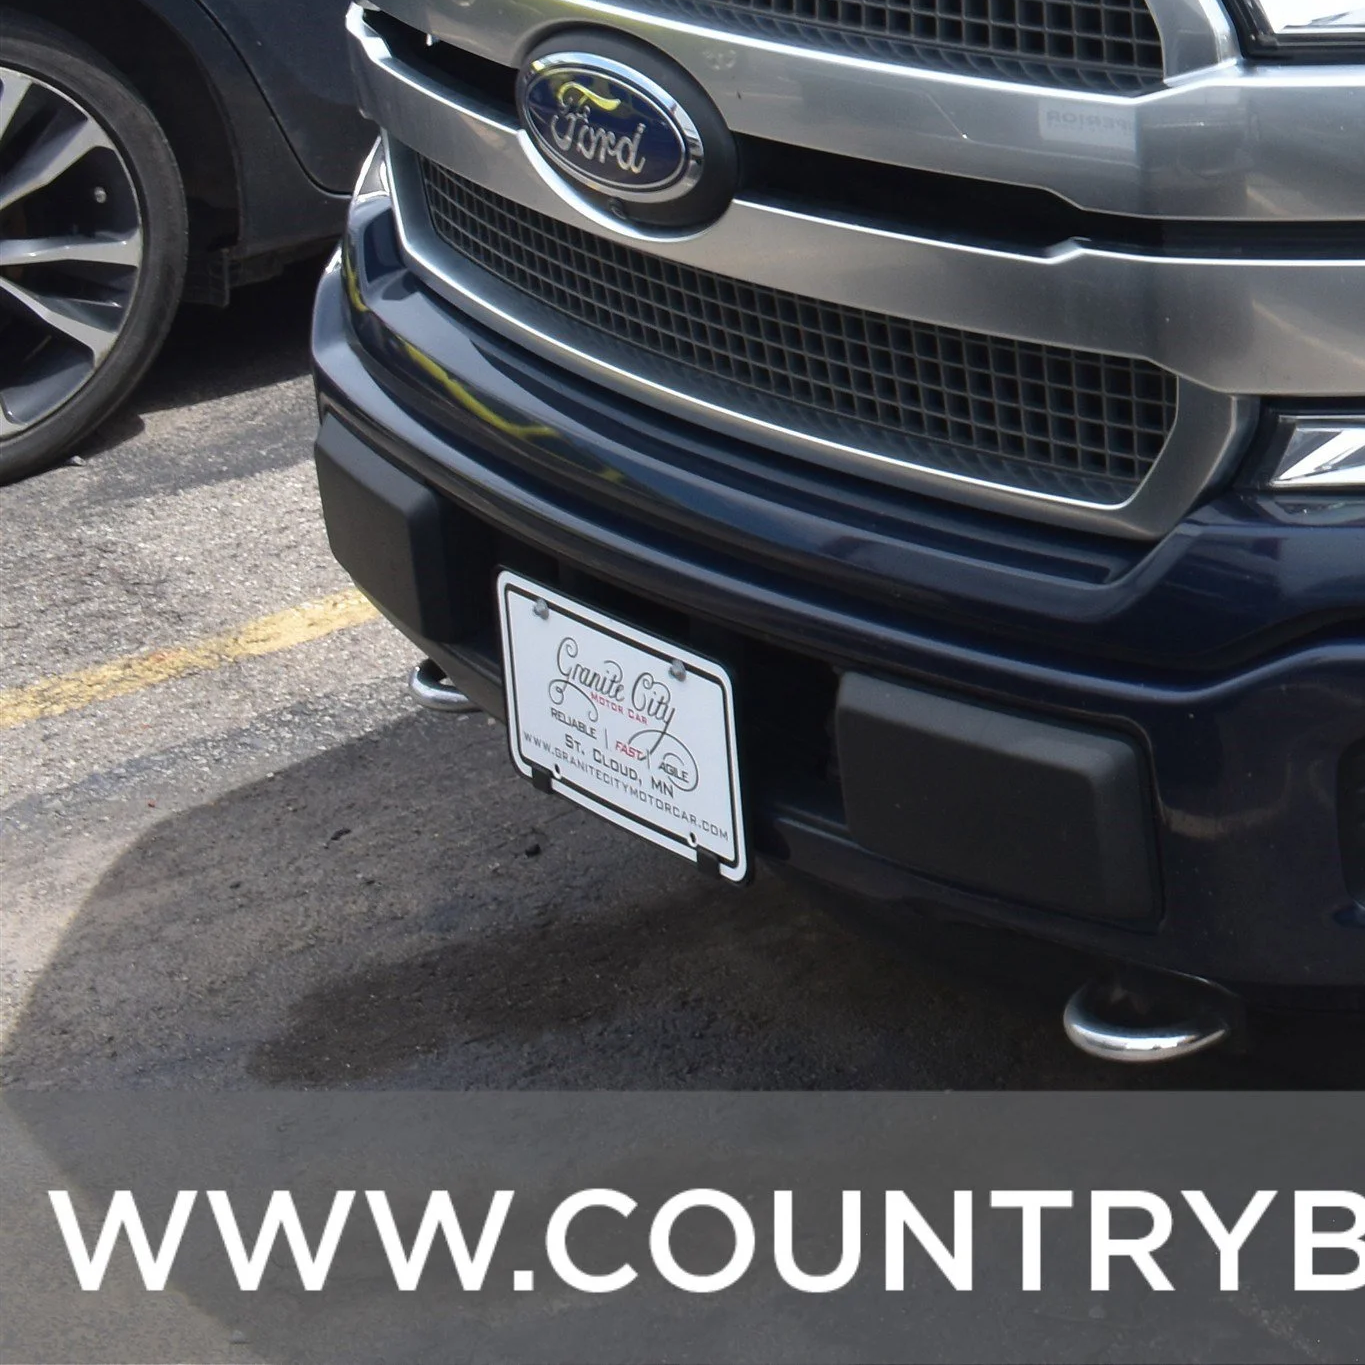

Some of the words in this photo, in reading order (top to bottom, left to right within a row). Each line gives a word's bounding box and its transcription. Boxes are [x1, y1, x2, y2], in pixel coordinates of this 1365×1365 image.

[551, 81, 647, 174] Ford
[549, 637, 625, 712] Granite
[630, 672, 677, 735] City
[591, 692, 624, 715] MOTOR
[628, 708, 648, 725] CAR
[524, 731, 729, 842] WWW.GRANITECITYMOTORCAR.COM
[550, 707, 597, 740] RELIABLE
[615, 740, 643, 760] FAST
[658, 760, 690, 784] AGILE
[564, 733, 585, 756] ST.
[593, 748, 643, 785] CLOUD,
[651, 776, 675, 799] MN
